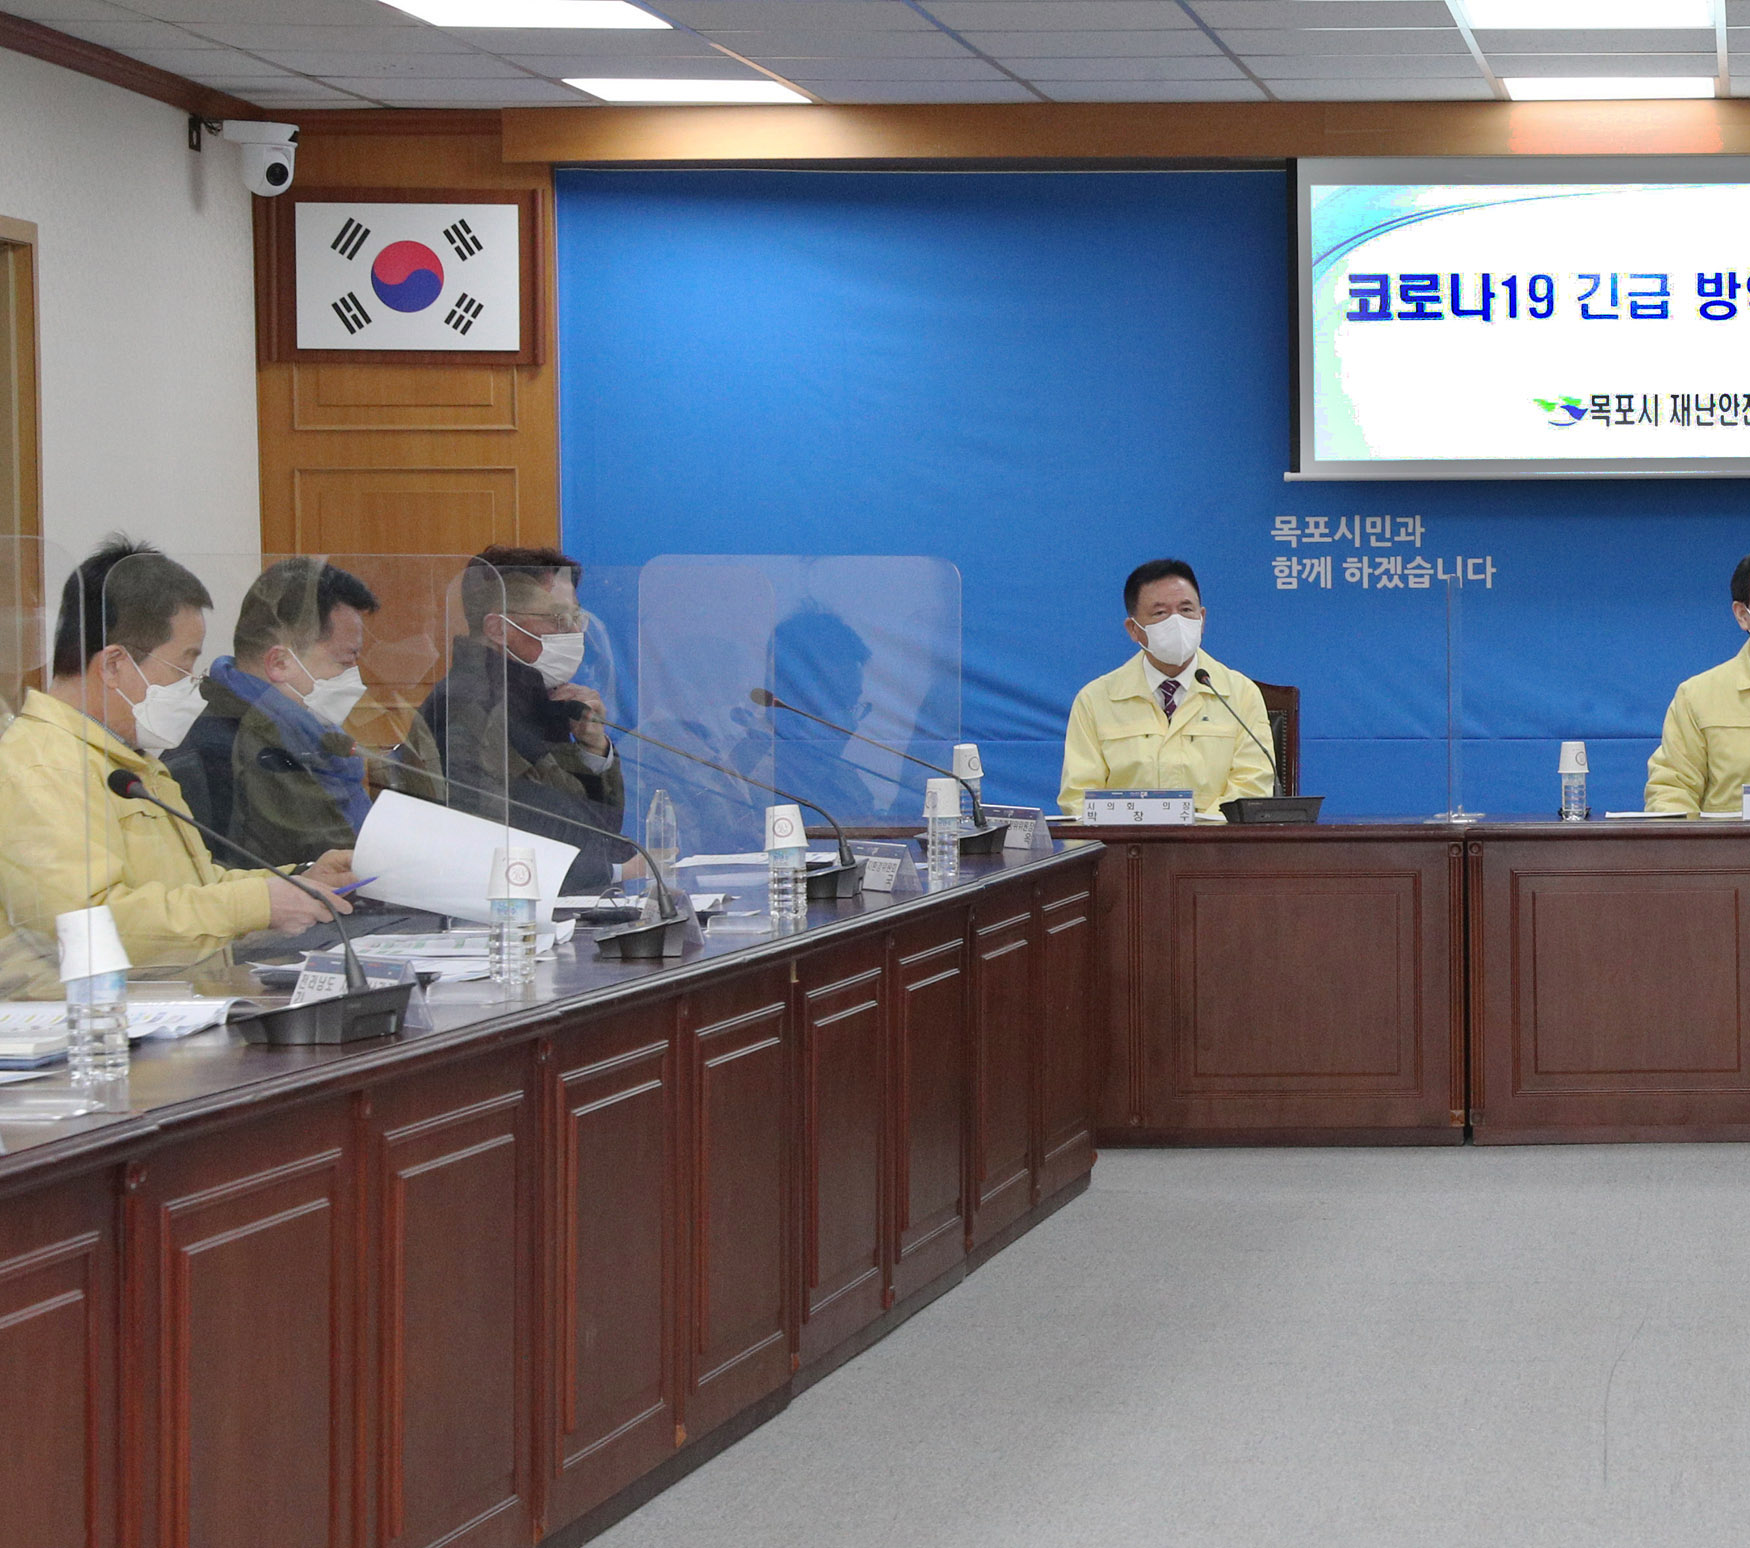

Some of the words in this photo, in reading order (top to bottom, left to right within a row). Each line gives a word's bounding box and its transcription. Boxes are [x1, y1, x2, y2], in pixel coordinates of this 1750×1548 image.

[1346, 272, 1556, 322] 코로나19
[1577, 273, 1671, 320] 긴급
[1590, 393, 1658, 427] 목포시
[1271, 514, 1426, 548] 목포시민과
[1271, 555, 1332, 589] 함께
[1342, 555, 1497, 589] 하겠습니다
